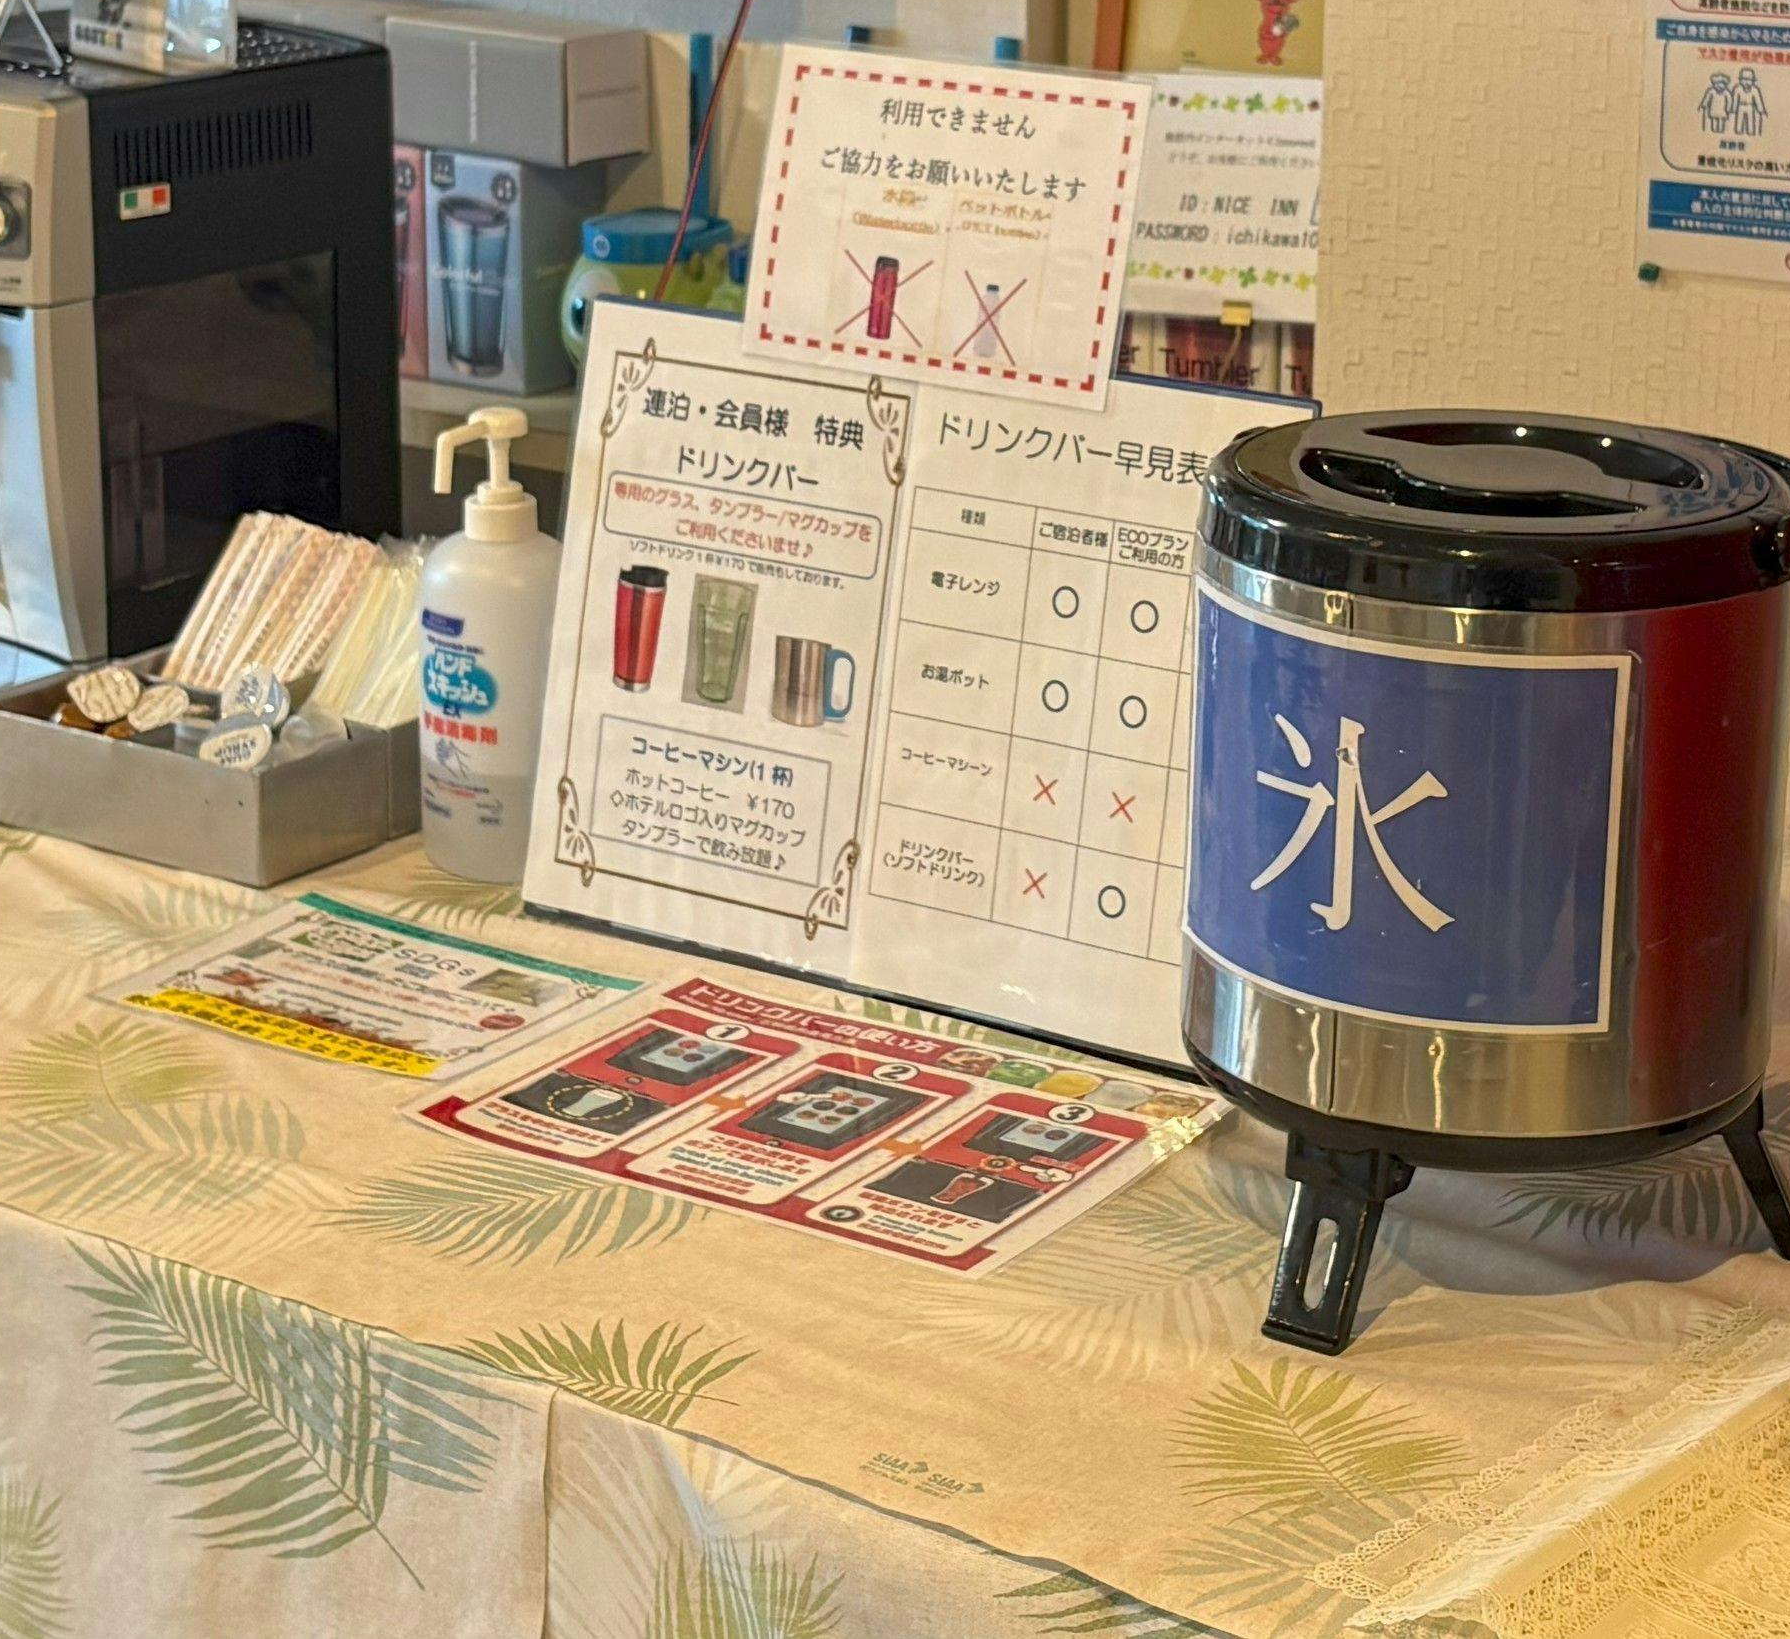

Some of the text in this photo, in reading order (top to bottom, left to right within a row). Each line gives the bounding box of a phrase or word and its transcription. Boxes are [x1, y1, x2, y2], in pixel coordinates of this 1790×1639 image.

[880, 98, 1036, 140] 利用できません
[820, 146, 1087, 203] ご協力をお願いいたします
[642, 387, 866, 451] 連泊・会員様 特典
[677, 444, 820, 491] ドリンクバー
[938, 410, 1211, 488] ドリンクバー早見表
[1038, 519, 1110, 550] ご宿泊者様
[1117, 544, 1187, 571] ご利用の方
[930, 568, 1001, 598] 電子レンジ
[434, 648, 475, 676] ハンド
[920, 662, 991, 691] お湯ポット
[900, 746, 994, 778] コーヒーマシーン
[625, 768, 796, 821] ホットコーヒー ¥170
[1250, 713, 1456, 933] 氷
[899, 838, 975, 867] ドリンクバー
[688, 985, 943, 1054] ドリンクバーの使い方
